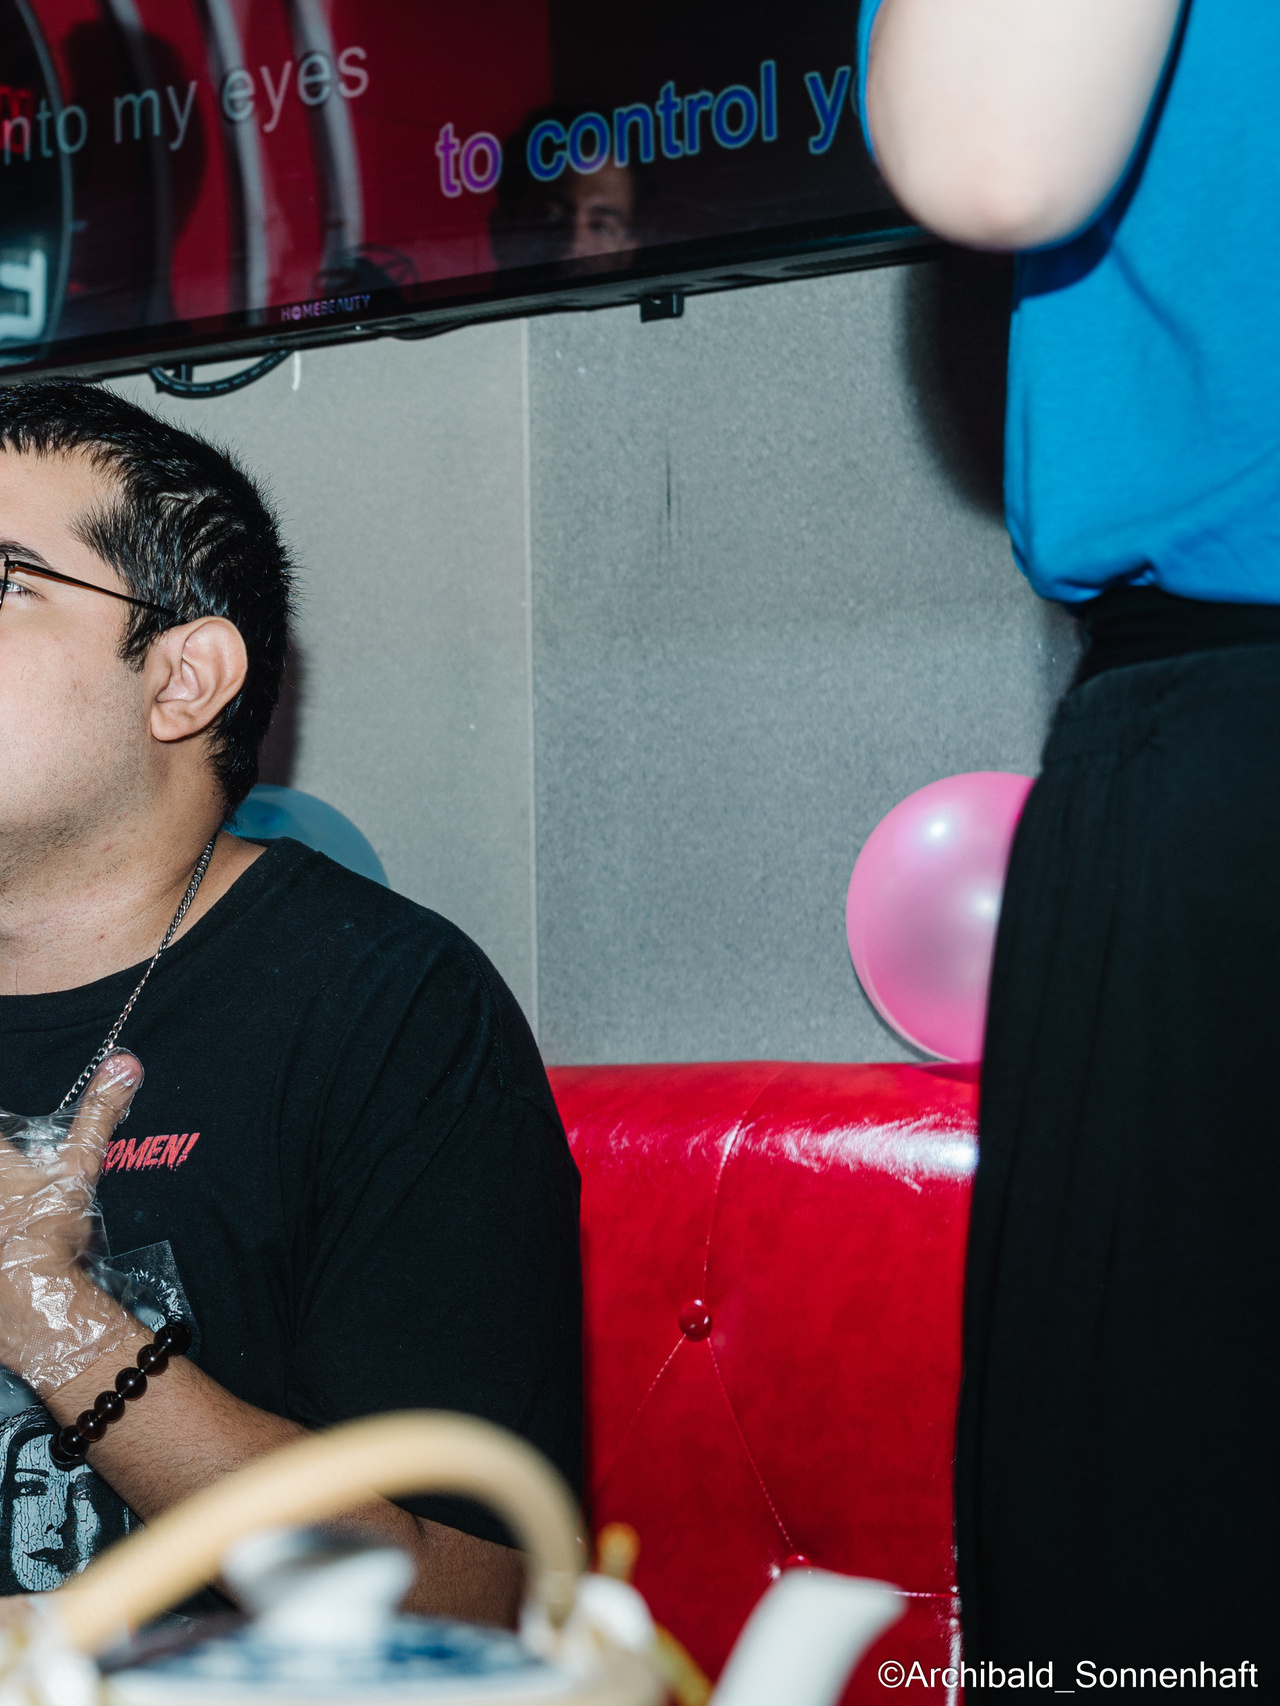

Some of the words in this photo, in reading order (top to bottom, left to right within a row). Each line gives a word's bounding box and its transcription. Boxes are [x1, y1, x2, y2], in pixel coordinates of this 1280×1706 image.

[113, 80, 197, 150] my
[222, 46, 369, 133] eyes
[435, 123, 502, 197] to
[526, 60, 776, 181] control
[804, 65, 858, 155] y
